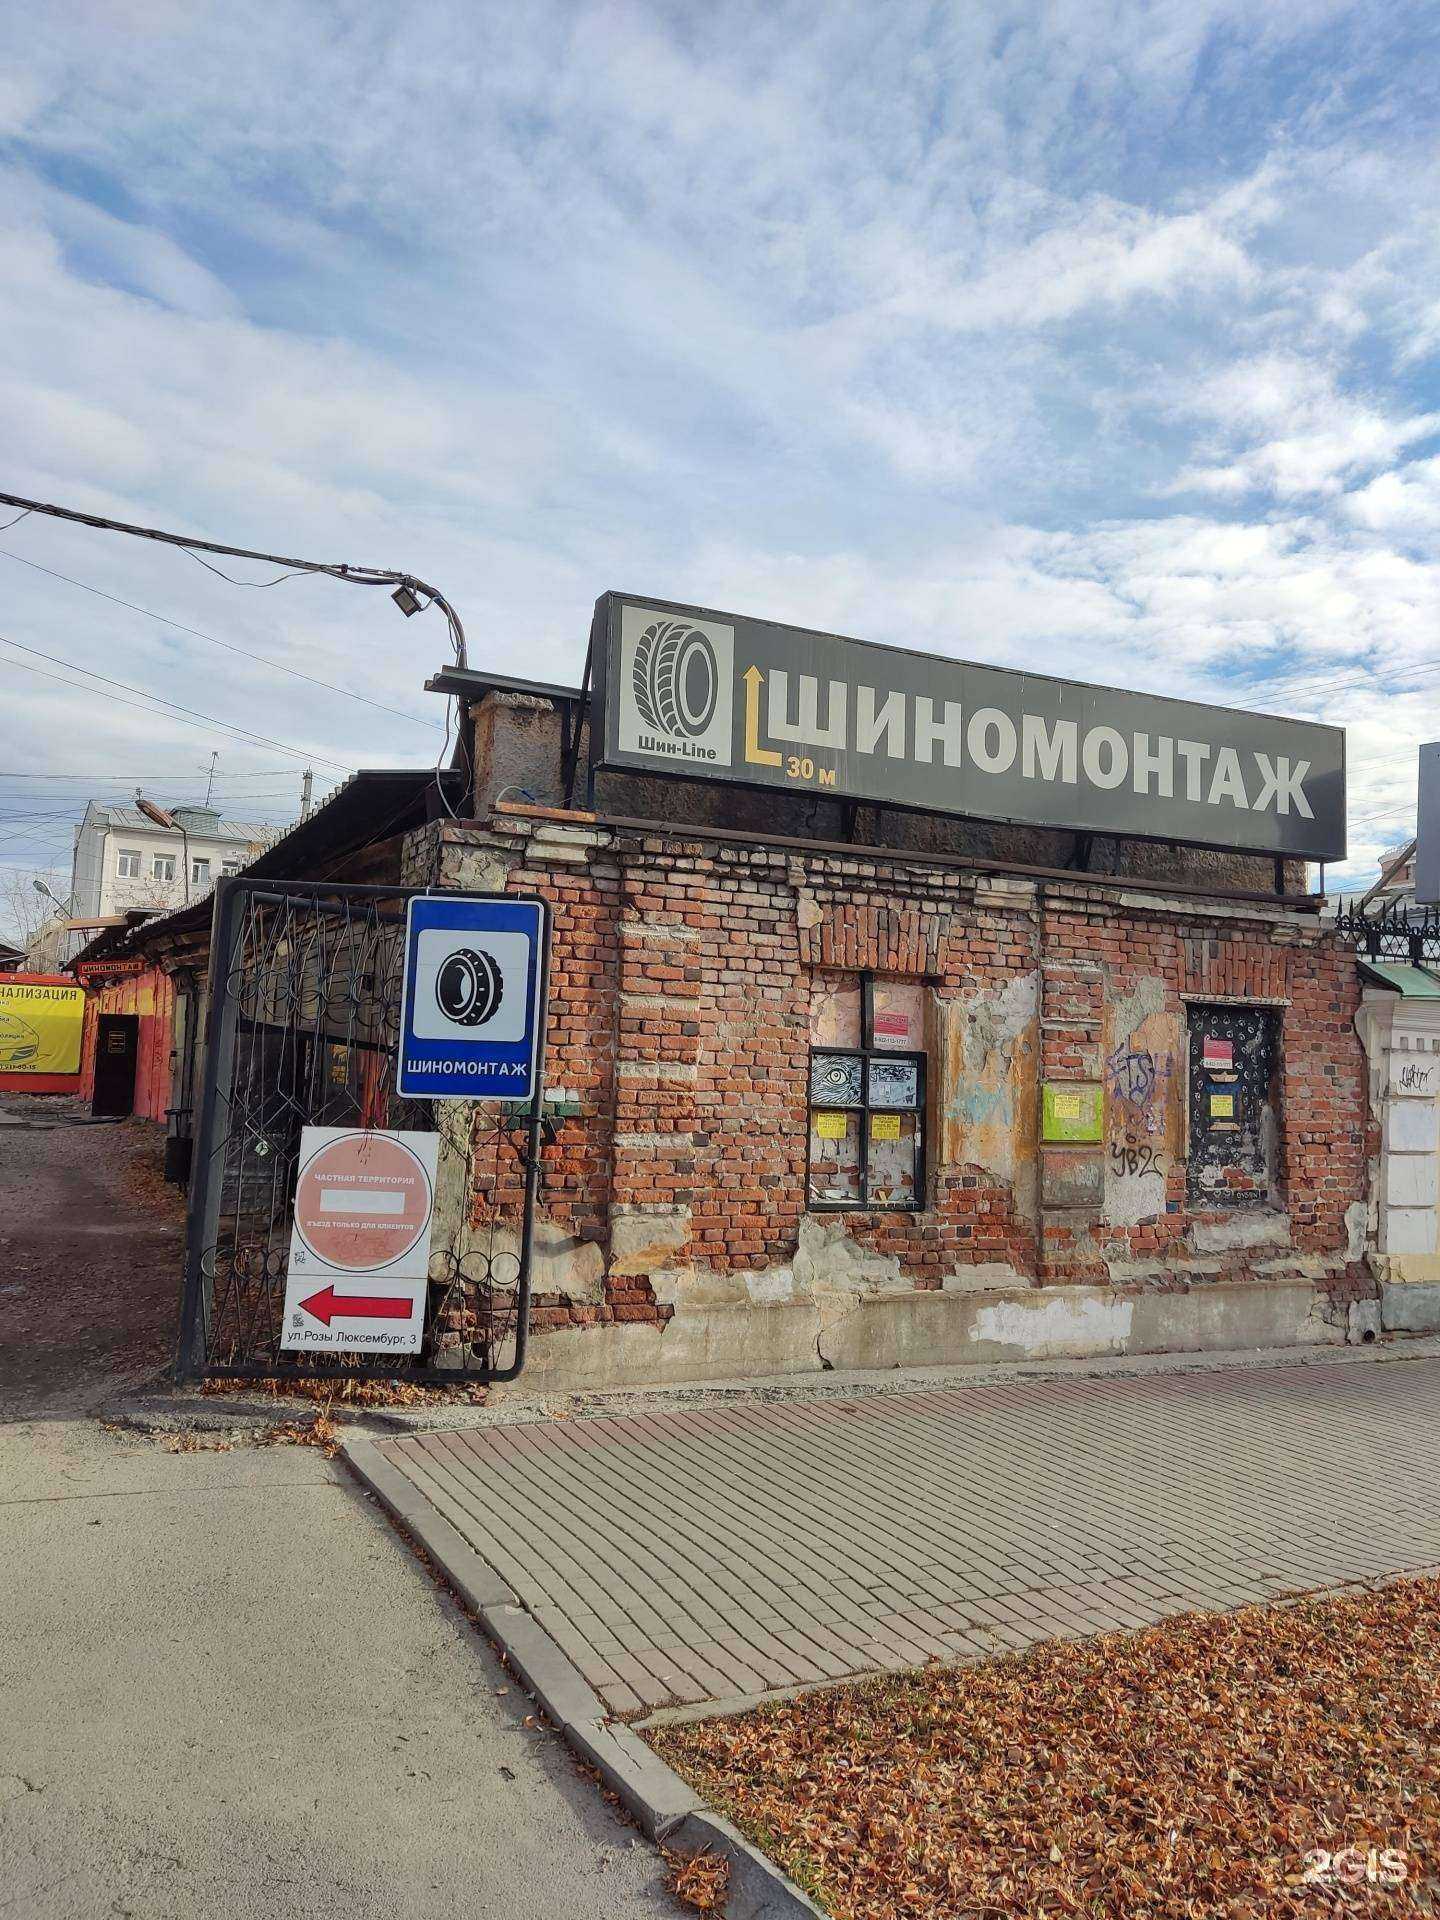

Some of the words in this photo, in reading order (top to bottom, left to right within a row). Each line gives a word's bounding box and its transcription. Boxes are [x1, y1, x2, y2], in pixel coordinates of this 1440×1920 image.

[638, 735, 717, 760] Шин-Line
[768, 669, 1315, 819] ШИНОМОНТАЖ
[786, 755, 814, 780] 30
[407, 1059, 527, 1077] ШИНОМОНТАЖ
[314, 1173, 356, 1183] ЧАСТНАЯ
[358, 1175, 416, 1185] ТЕРРИТОРИЯ
[335, 1331, 406, 1346] Люксембург,
[409, 1334, 417, 1345] 3
